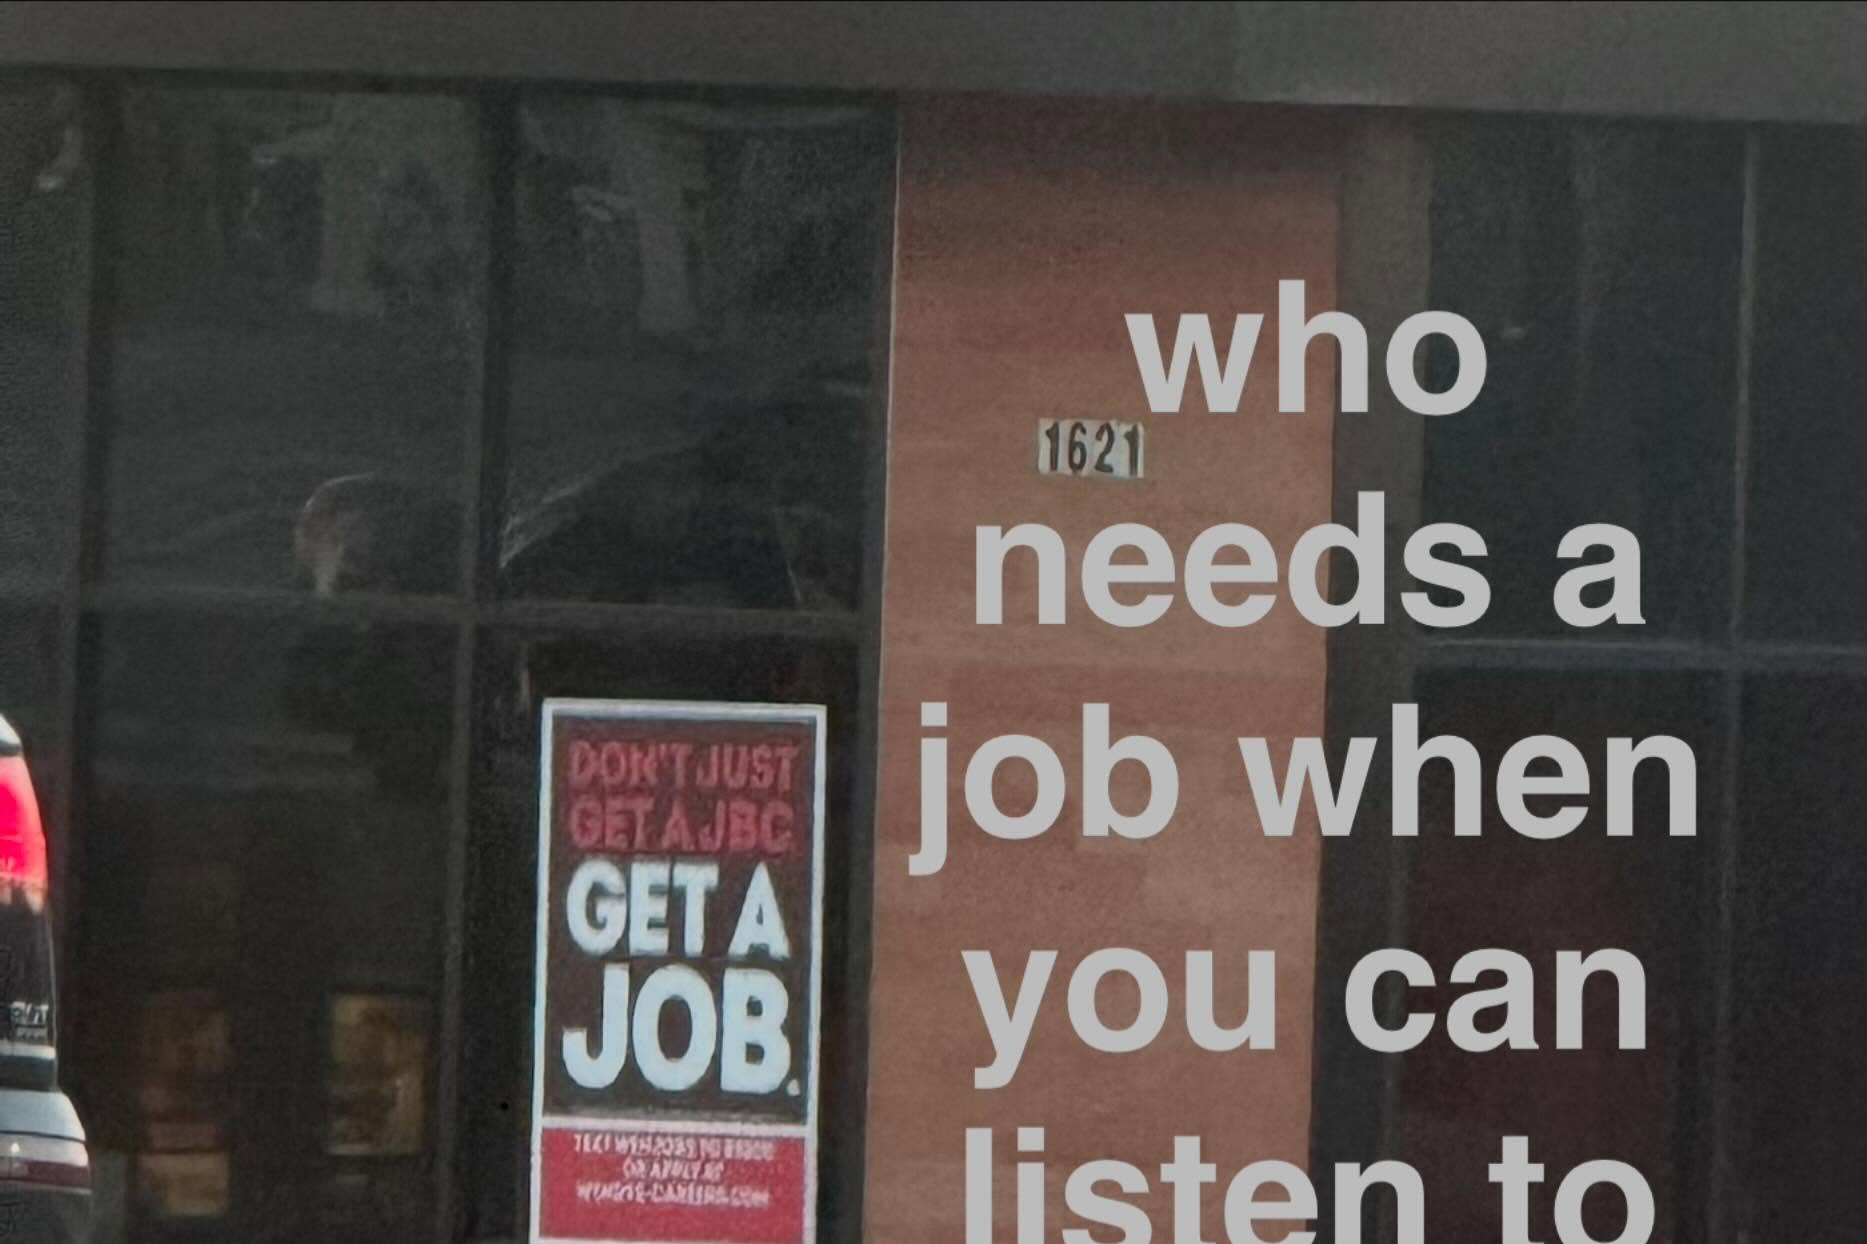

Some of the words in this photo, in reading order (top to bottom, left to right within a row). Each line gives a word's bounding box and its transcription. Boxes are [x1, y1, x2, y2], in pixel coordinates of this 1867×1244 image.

[1044, 420, 1140, 477] 1621
[568, 739, 693, 789] DON'T
[695, 743, 799, 792] JUST
[568, 795, 654, 850] GET
[661, 801, 696, 850] A
[567, 859, 719, 957] GET
[728, 861, 791, 960] A
[562, 961, 800, 1096] JOB.
